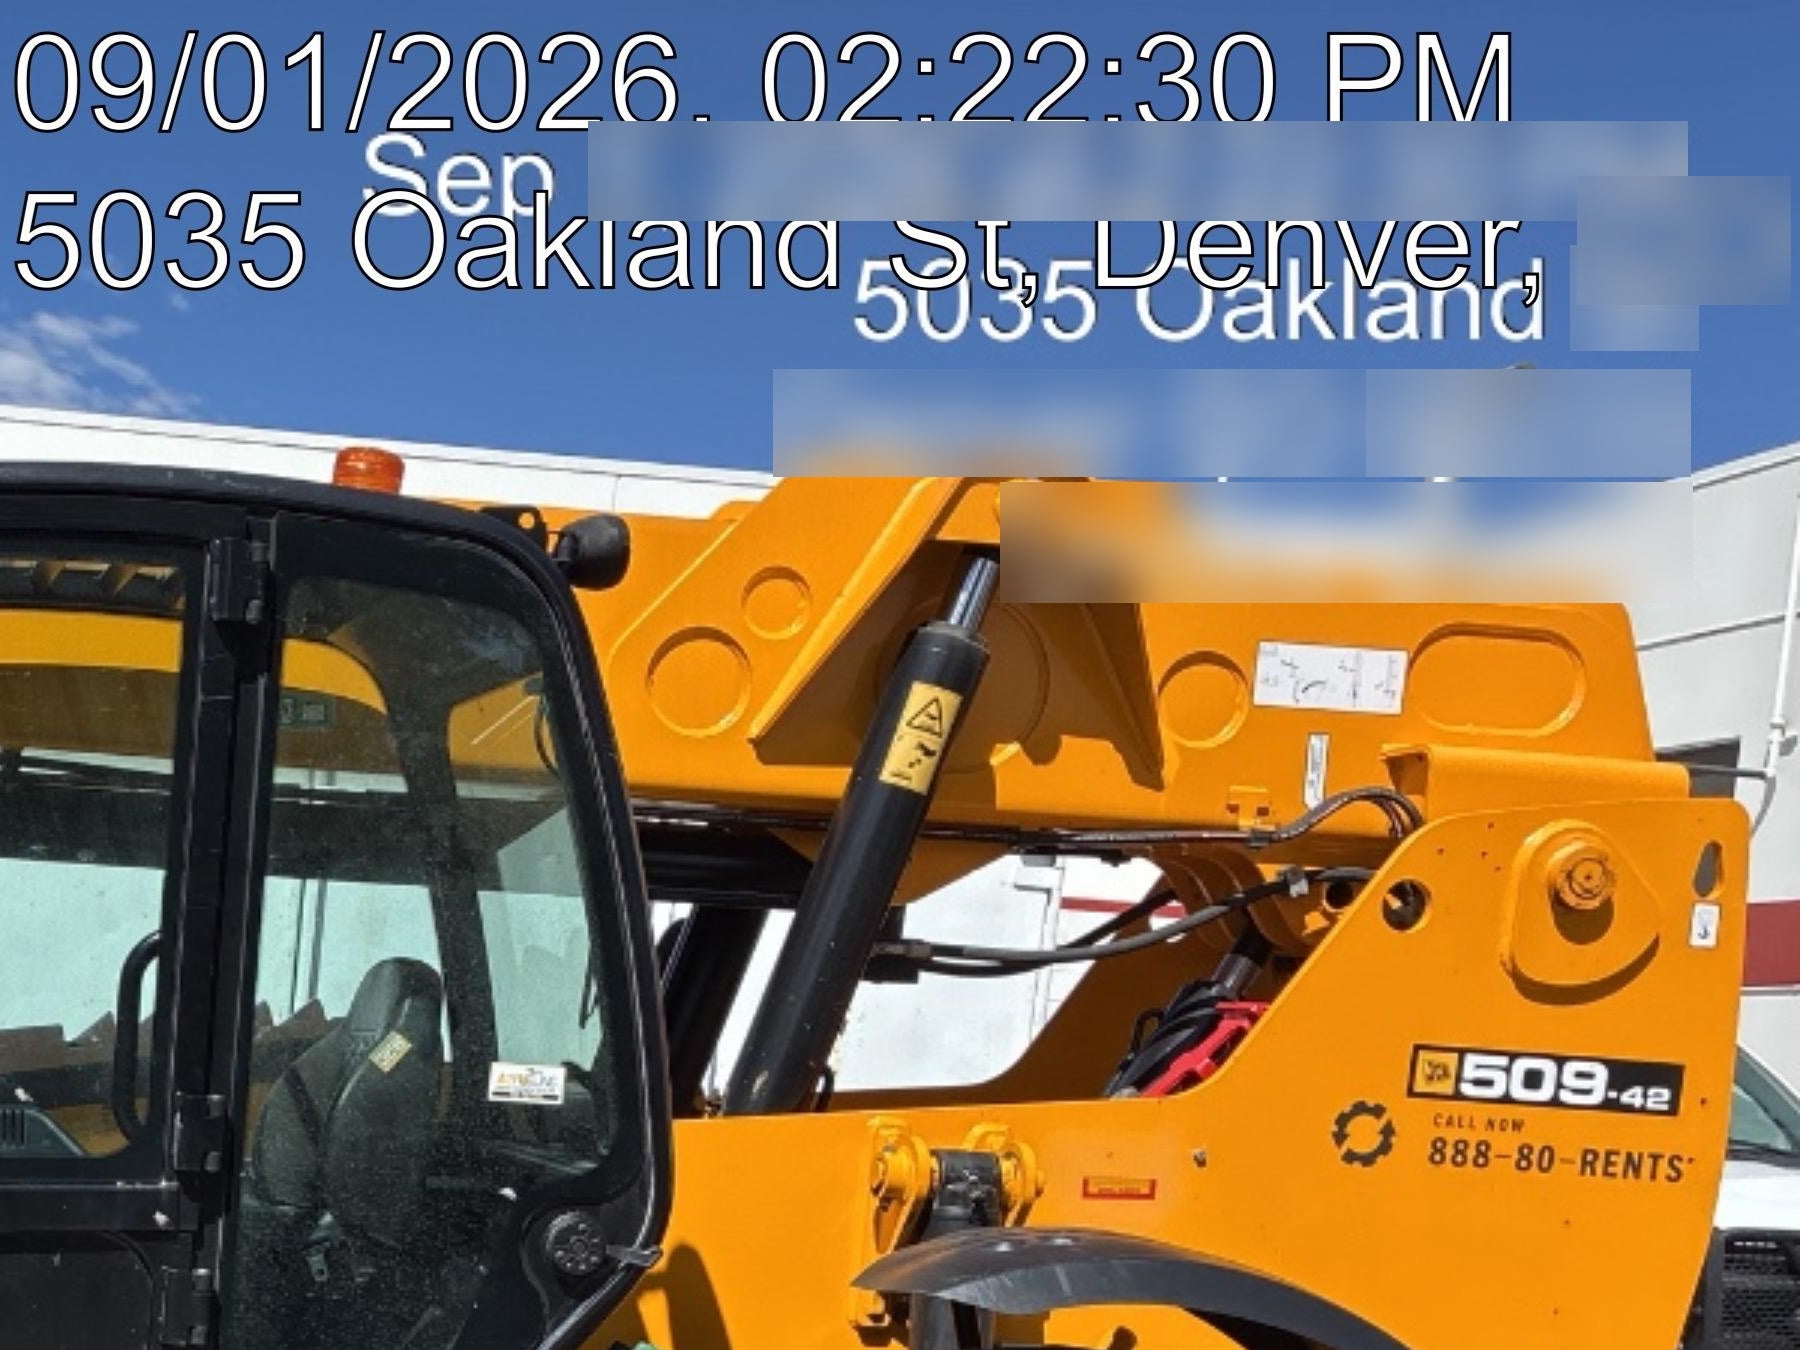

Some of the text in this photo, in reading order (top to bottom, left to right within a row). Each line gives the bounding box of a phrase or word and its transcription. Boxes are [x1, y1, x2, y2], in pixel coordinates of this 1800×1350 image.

[1459, 1051, 1673, 1112] 509-42
[1432, 1112, 1526, 1133] CALL NOW
